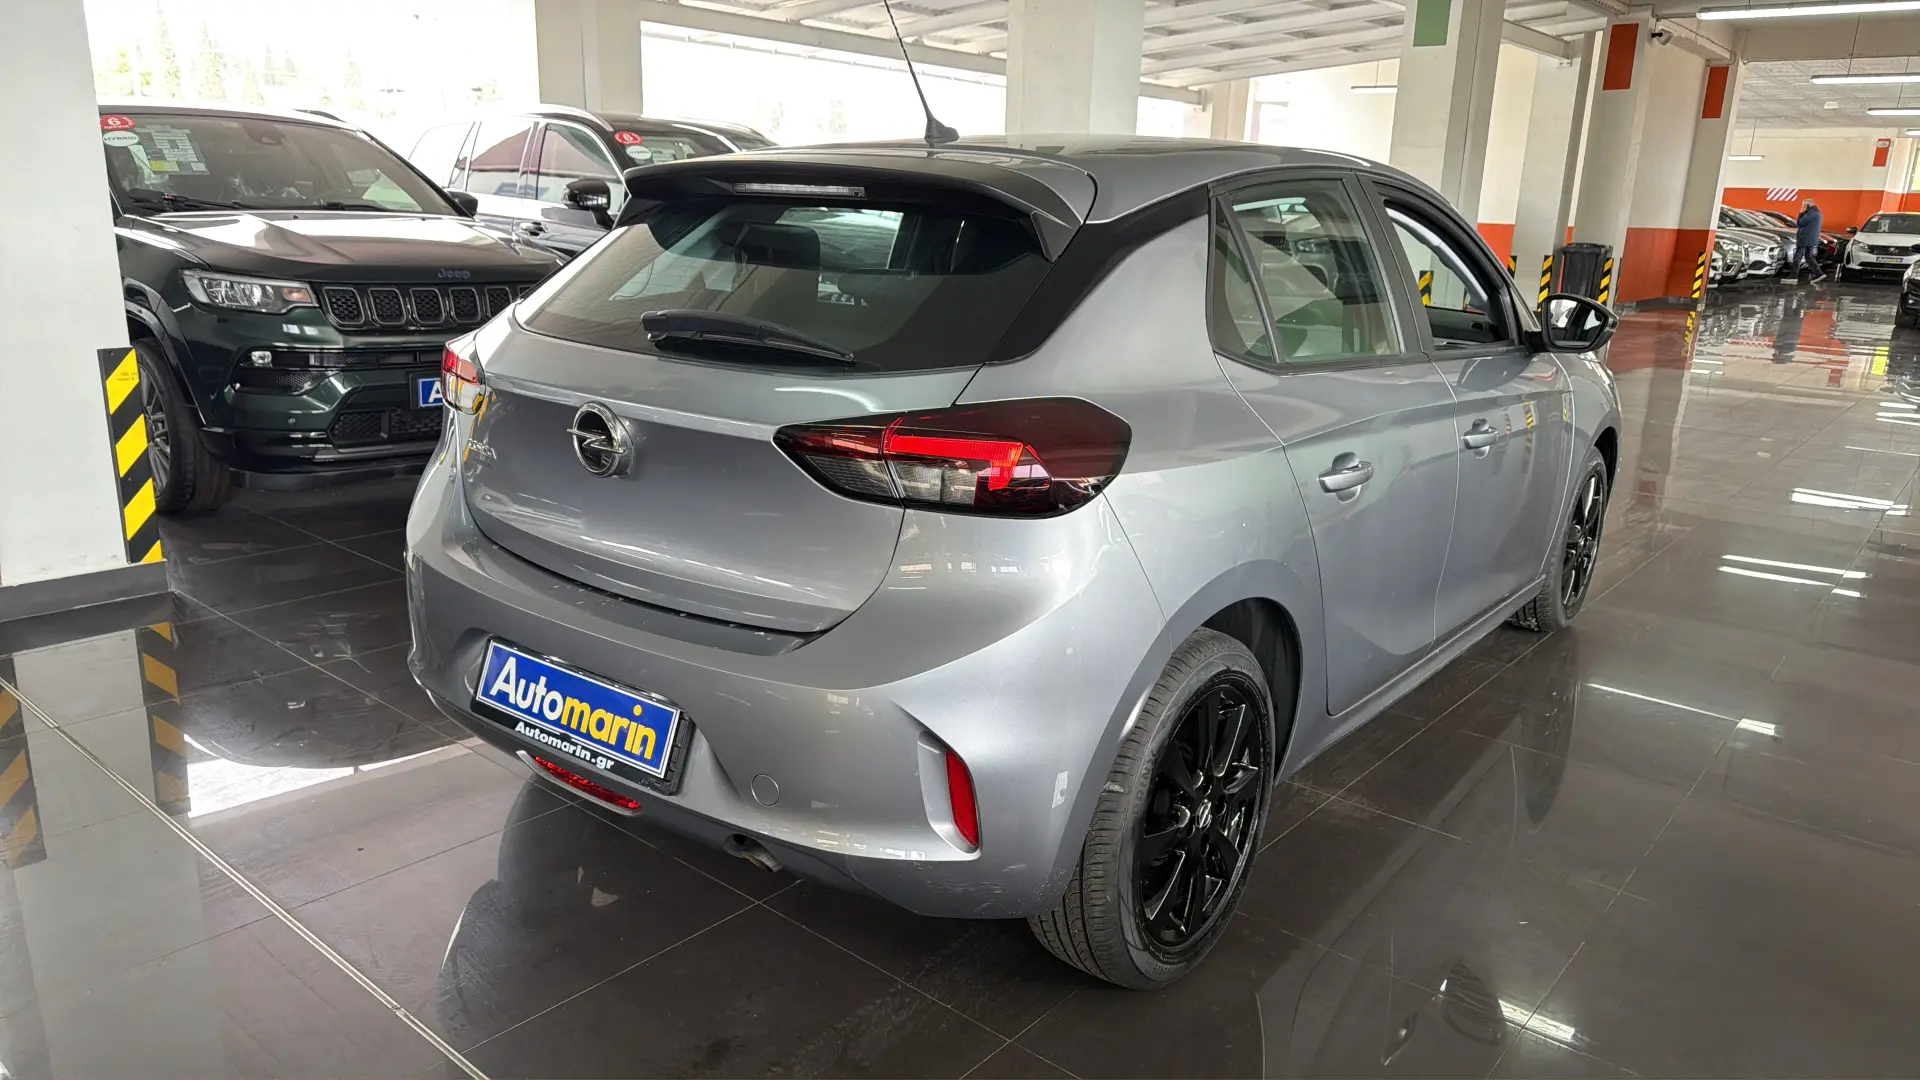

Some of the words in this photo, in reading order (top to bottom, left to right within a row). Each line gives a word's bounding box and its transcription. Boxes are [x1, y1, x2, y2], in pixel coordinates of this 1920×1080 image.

[108, 117, 121, 125] 6
[437, 268, 471, 279] Jeep
[490, 656, 656, 760] Automarin
[514, 721, 615, 770] Automarin.gr
